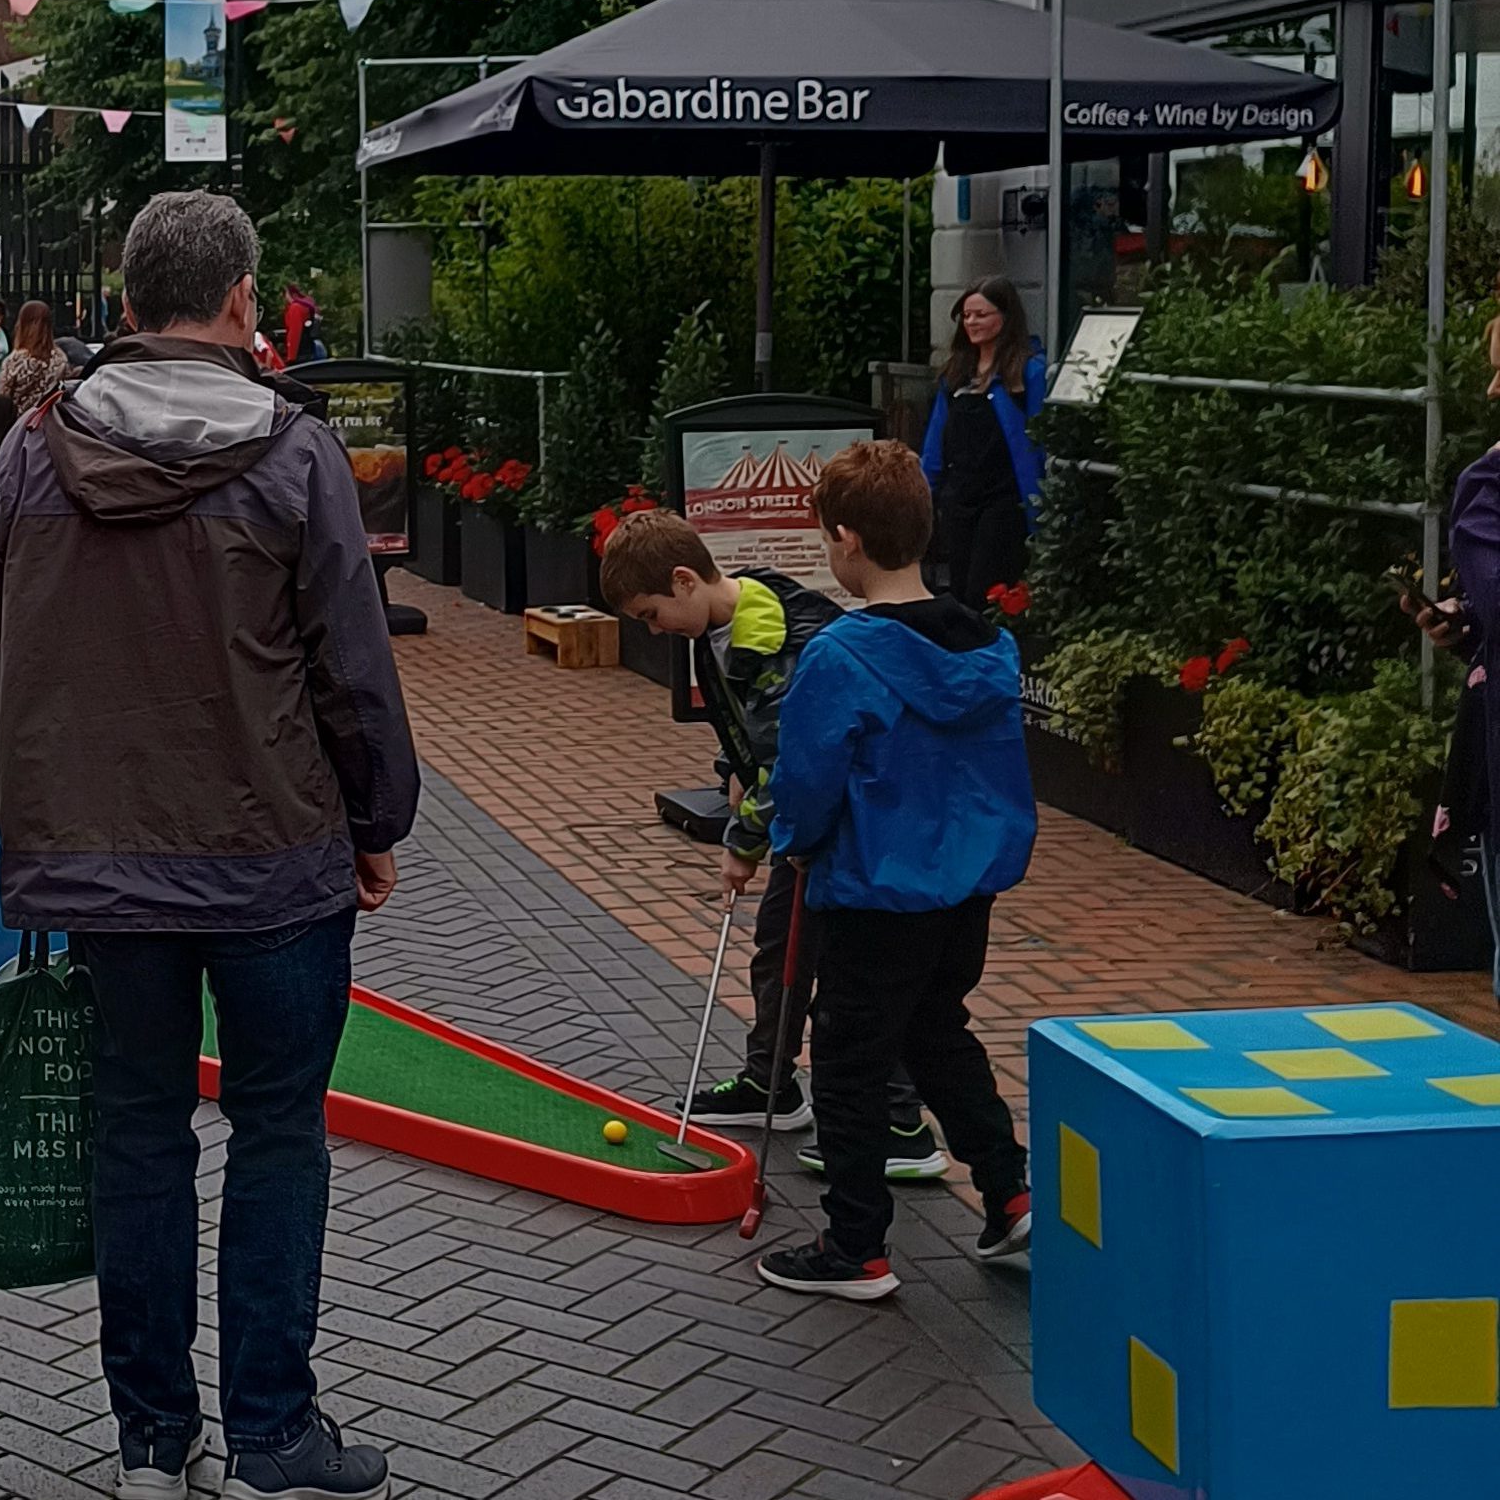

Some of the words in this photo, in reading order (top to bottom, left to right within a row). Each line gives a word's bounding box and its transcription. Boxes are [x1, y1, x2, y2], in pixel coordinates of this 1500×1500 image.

[557, 78, 790, 120] Gabardine
[798, 80, 870, 120] Bar
[1063, 102, 1129, 126] Coffee
[1155, 102, 1208, 127] Wine
[1212, 102, 1238, 131] by
[1242, 103, 1314, 131] Design
[686, 497, 747, 516] LONDON
[750, 494, 799, 509] STREET
[18, 1036, 67, 1056] NOT
[35, 1112, 81, 1132] THI
[14, 1139, 66, 1160] M&S
[19, 1185, 27, 1193] is
[31, 1184, 56, 1194] made
[60, 1184, 82, 1193] from
[33, 1199, 66, 1208] turning
[69, 1199, 85, 1207] old
